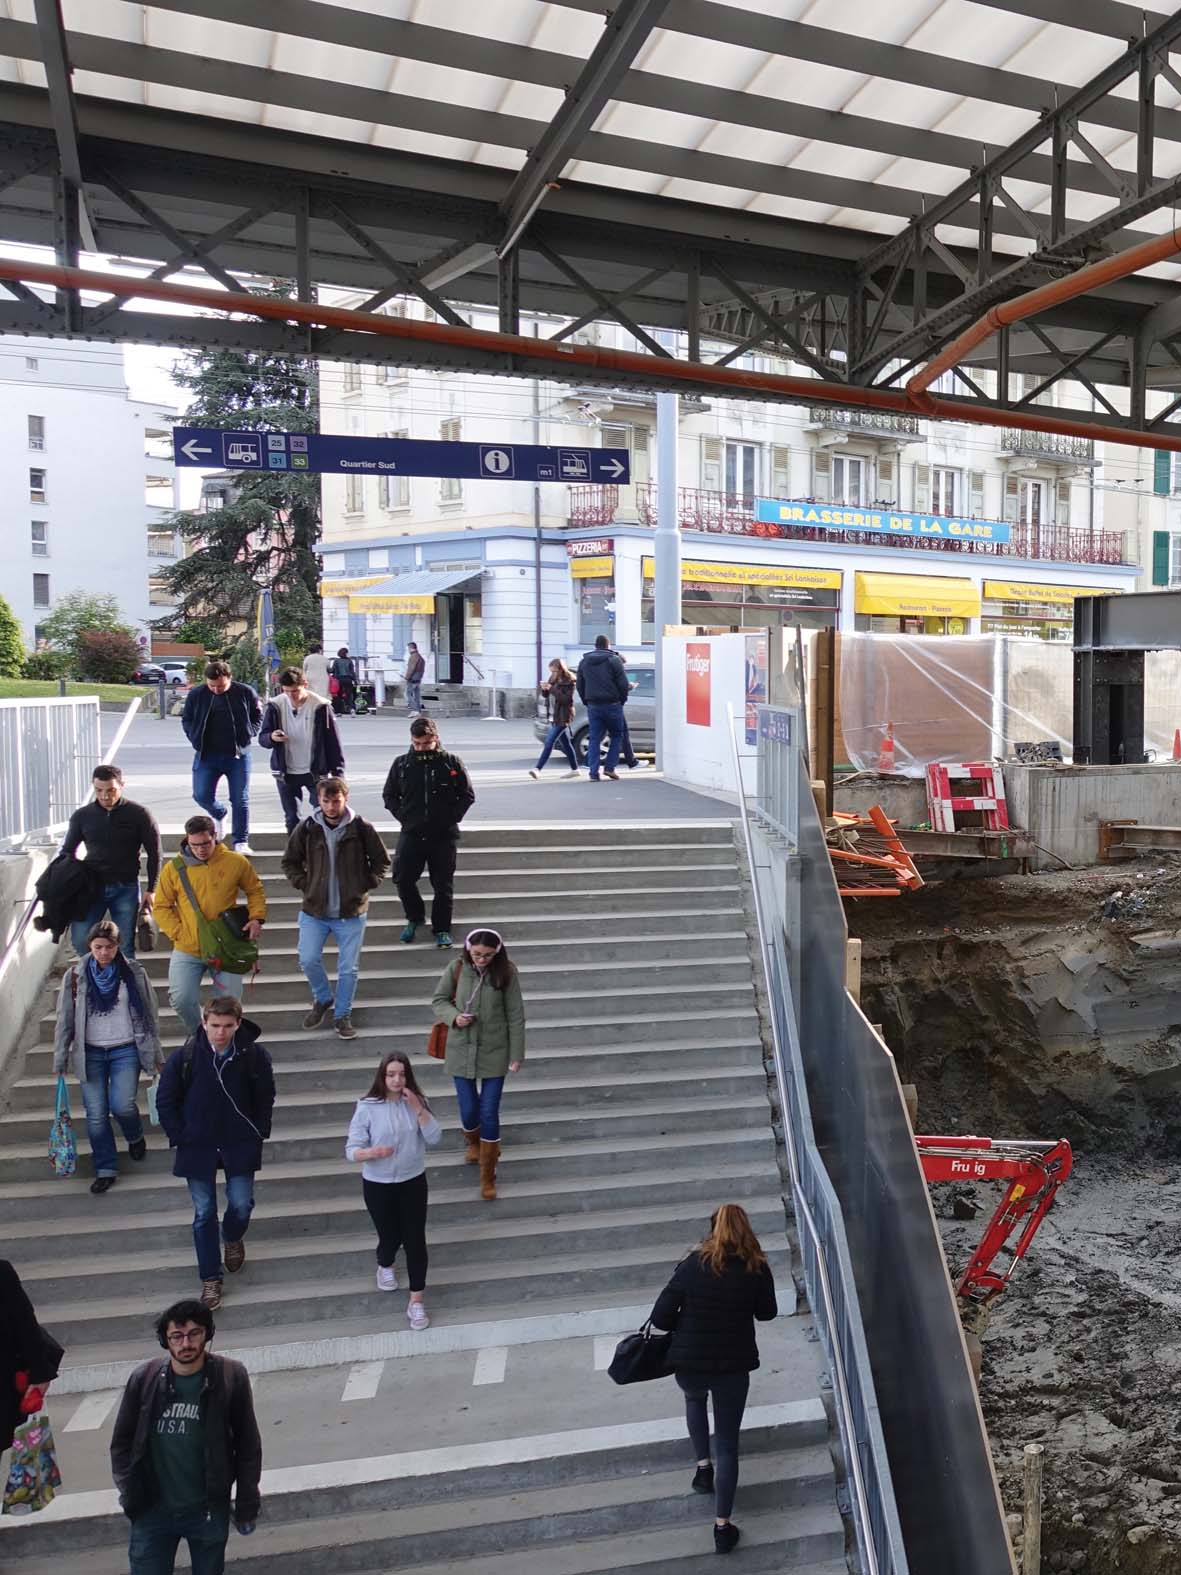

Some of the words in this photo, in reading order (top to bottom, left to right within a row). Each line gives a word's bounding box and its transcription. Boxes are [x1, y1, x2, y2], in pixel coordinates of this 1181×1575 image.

[271, 439, 282, 448] 25
[292, 440, 305, 448] 32
[272, 457, 283, 465] 31
[294, 458, 305, 466] 33
[339, 459, 376, 469] Quartier
[377, 460, 396, 470] Sud
[779, 506, 882, 529] BRASSERIE
[889, 517, 913, 531] DE
[920, 519, 943, 533] LA
[948, 521, 993, 538] GARE
[572, 541, 603, 554] PIZZERIA
[162, 1402, 200, 1420] STRAU
